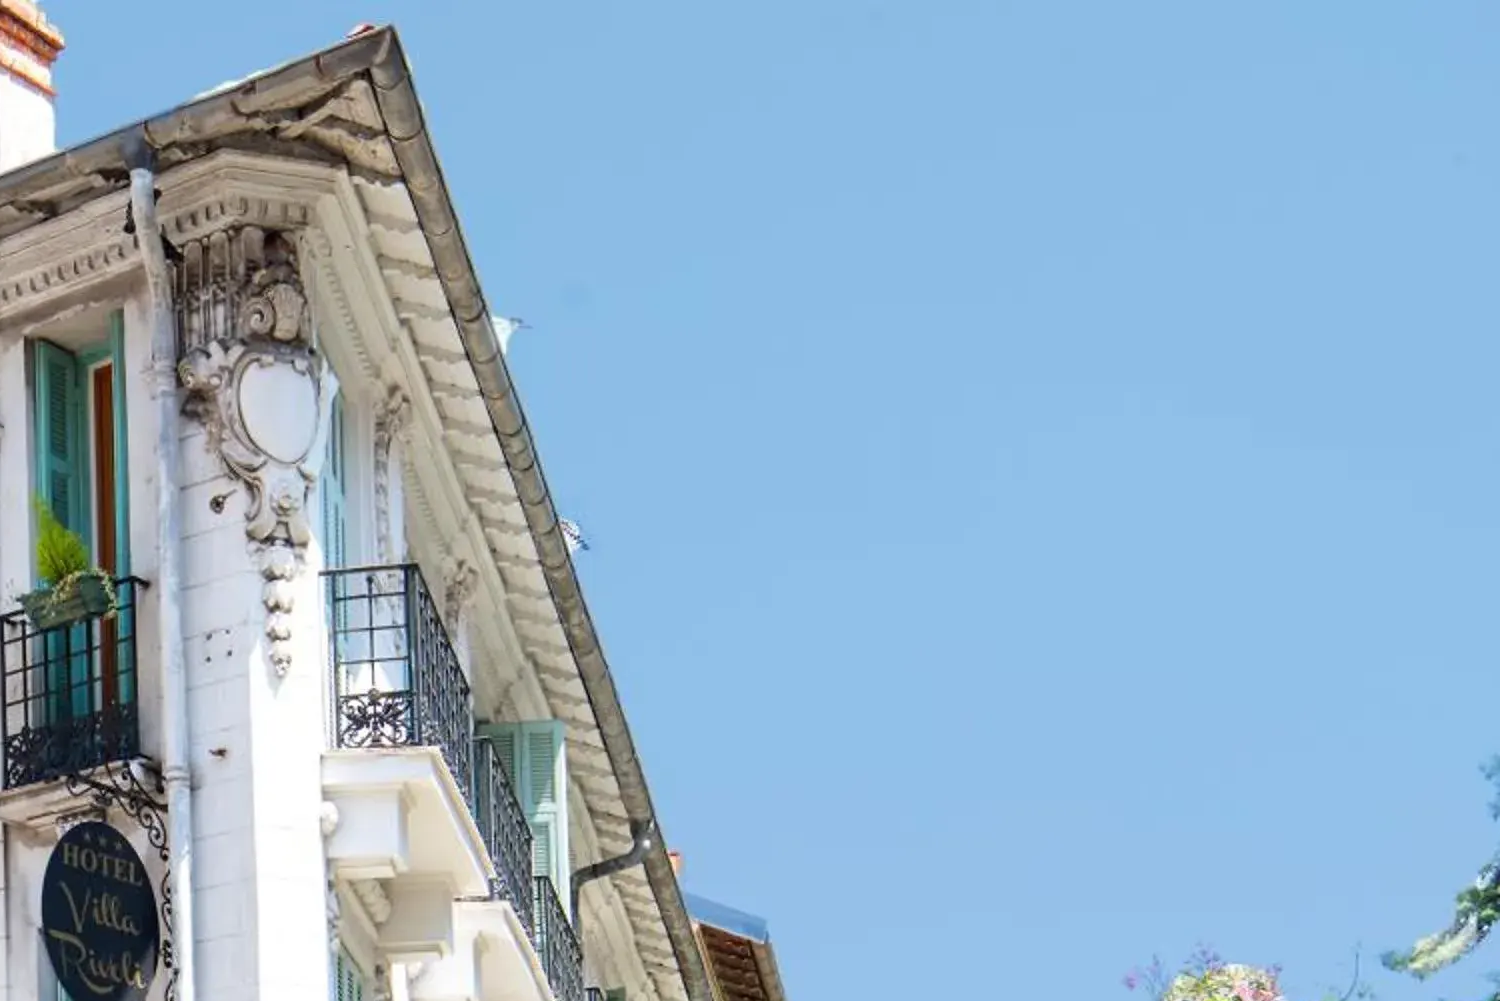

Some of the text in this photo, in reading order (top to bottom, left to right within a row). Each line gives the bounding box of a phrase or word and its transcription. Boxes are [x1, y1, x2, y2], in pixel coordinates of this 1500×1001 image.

[62, 842, 143, 887] HOTEL
[59, 880, 141, 937] Villa
[49, 929, 148, 995] Rivoli
